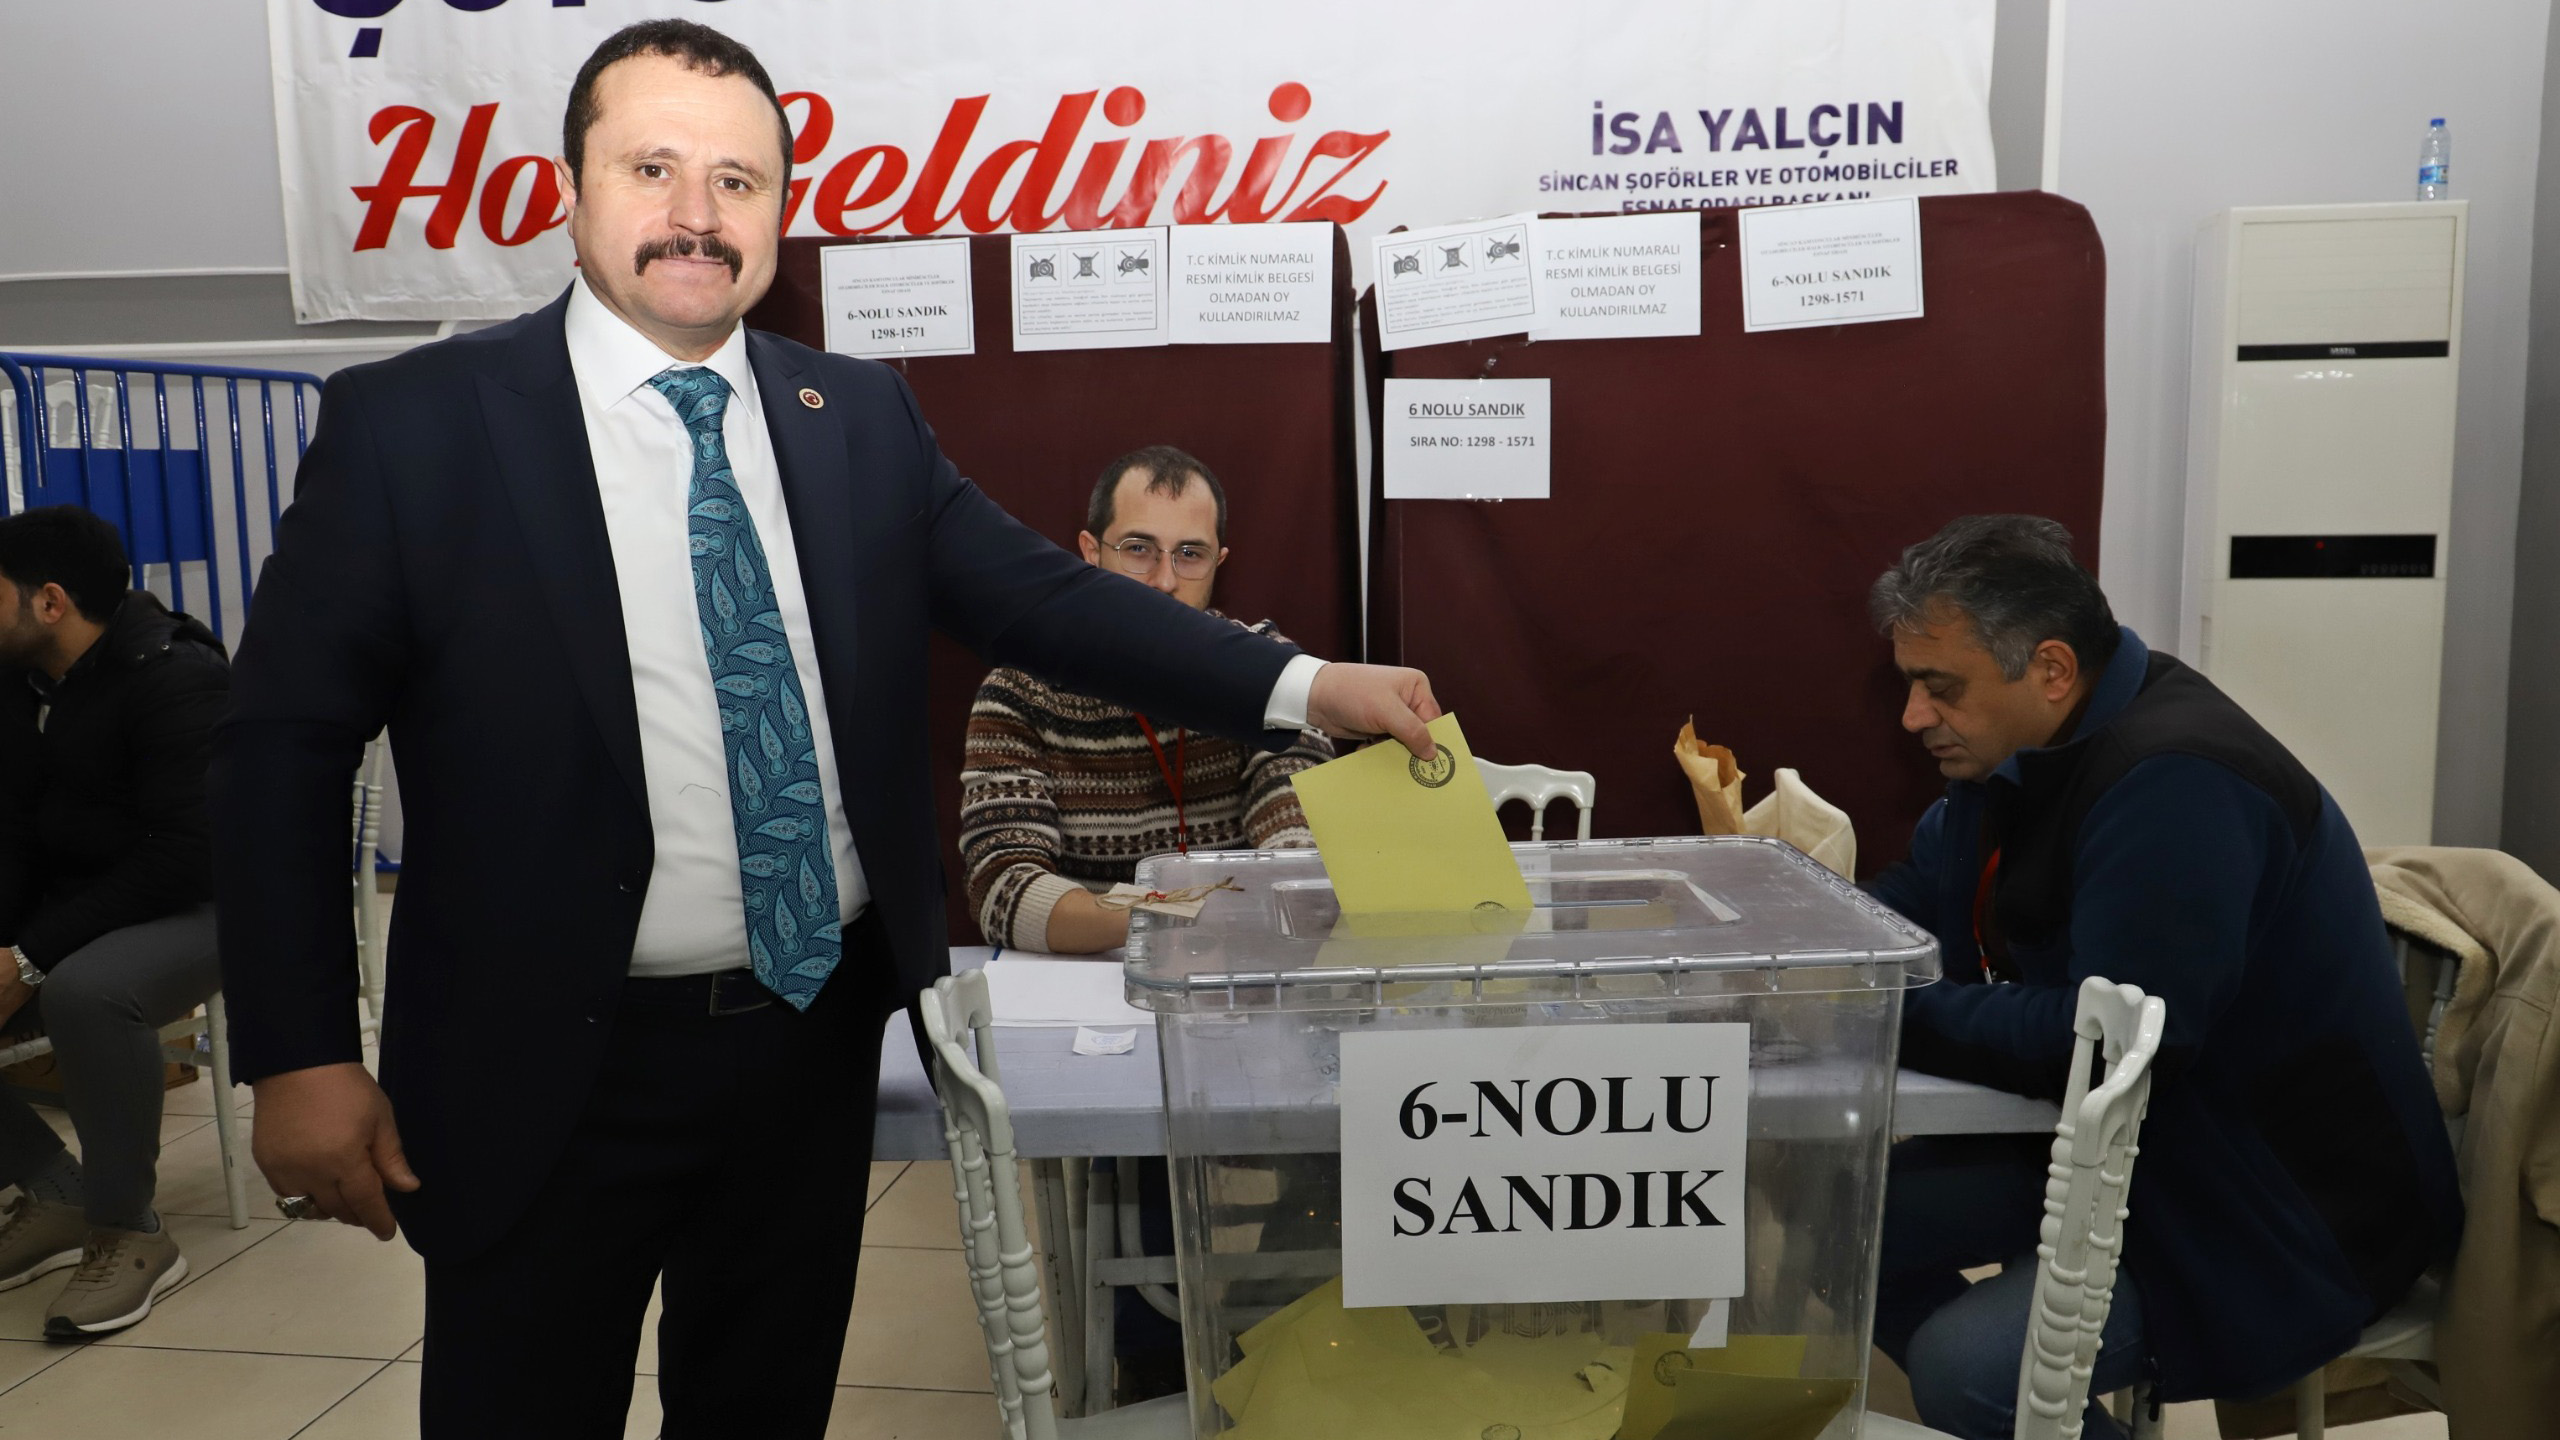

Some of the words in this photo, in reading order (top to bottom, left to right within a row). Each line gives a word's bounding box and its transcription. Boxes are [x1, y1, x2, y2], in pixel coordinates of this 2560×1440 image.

[1592, 101, 1682, 155] İSA
[1698, 101, 1903, 158] YALÇIN
[350, 102, 567, 253] Ho
[1539, 168, 1619, 191] SİNCAN
[1626, 166, 1739, 194] ŞOFÖRLER
[1745, 168, 1772, 185] VE
[1780, 158, 1958, 185] OTOMOBİLCİLER
[1622, 199, 1693, 210] ESNAF
[1208, 252, 1246, 265] KİMLİK
[1250, 253, 1313, 264] NUMARALI
[1568, 245, 1610, 260] KİMLİK
[1613, 244, 1680, 257] NUMARALI
[1186, 272, 1222, 284] RESMİ
[1226, 271, 1265, 284] KİMLİK
[1268, 270, 1314, 283] BELGESİ
[1545, 266, 1583, 280] RESMİ
[1587, 264, 1629, 278] KİMLİK
[1633, 261, 1681, 276] BELGESİ
[1772, 271, 1828, 287] 6-NOLU
[1832, 265, 1891, 282] SANDIK
[1210, 292, 1270, 303] OLMADAN
[1273, 291, 1290, 302] OY
[1570, 285, 1635, 298] OLMADAN
[1639, 284, 1656, 295] OY
[1801, 290, 1864, 307] 1298-1571
[847, 308, 894, 320] 6-NOLU
[897, 305, 947, 318] SANDIK
[1199, 310, 1300, 322] KULLANDIRILMAZ
[1560, 303, 1667, 318] KULLANDIRILMAZ
[871, 327, 925, 340] 1298-1571
[1409, 403, 1417, 416] 6
[1422, 403, 1464, 416] NOLU
[1468, 403, 1525, 416] SANDIK
[1410, 436, 1437, 447] SIRA
[1441, 436, 1463, 447] NO:
[1467, 436, 1495, 447] 1298
[1507, 436, 1535, 447] 1571
[1399, 1076, 1720, 1140] 6-NOLU
[1393, 1169, 1726, 1238] SANDIK
